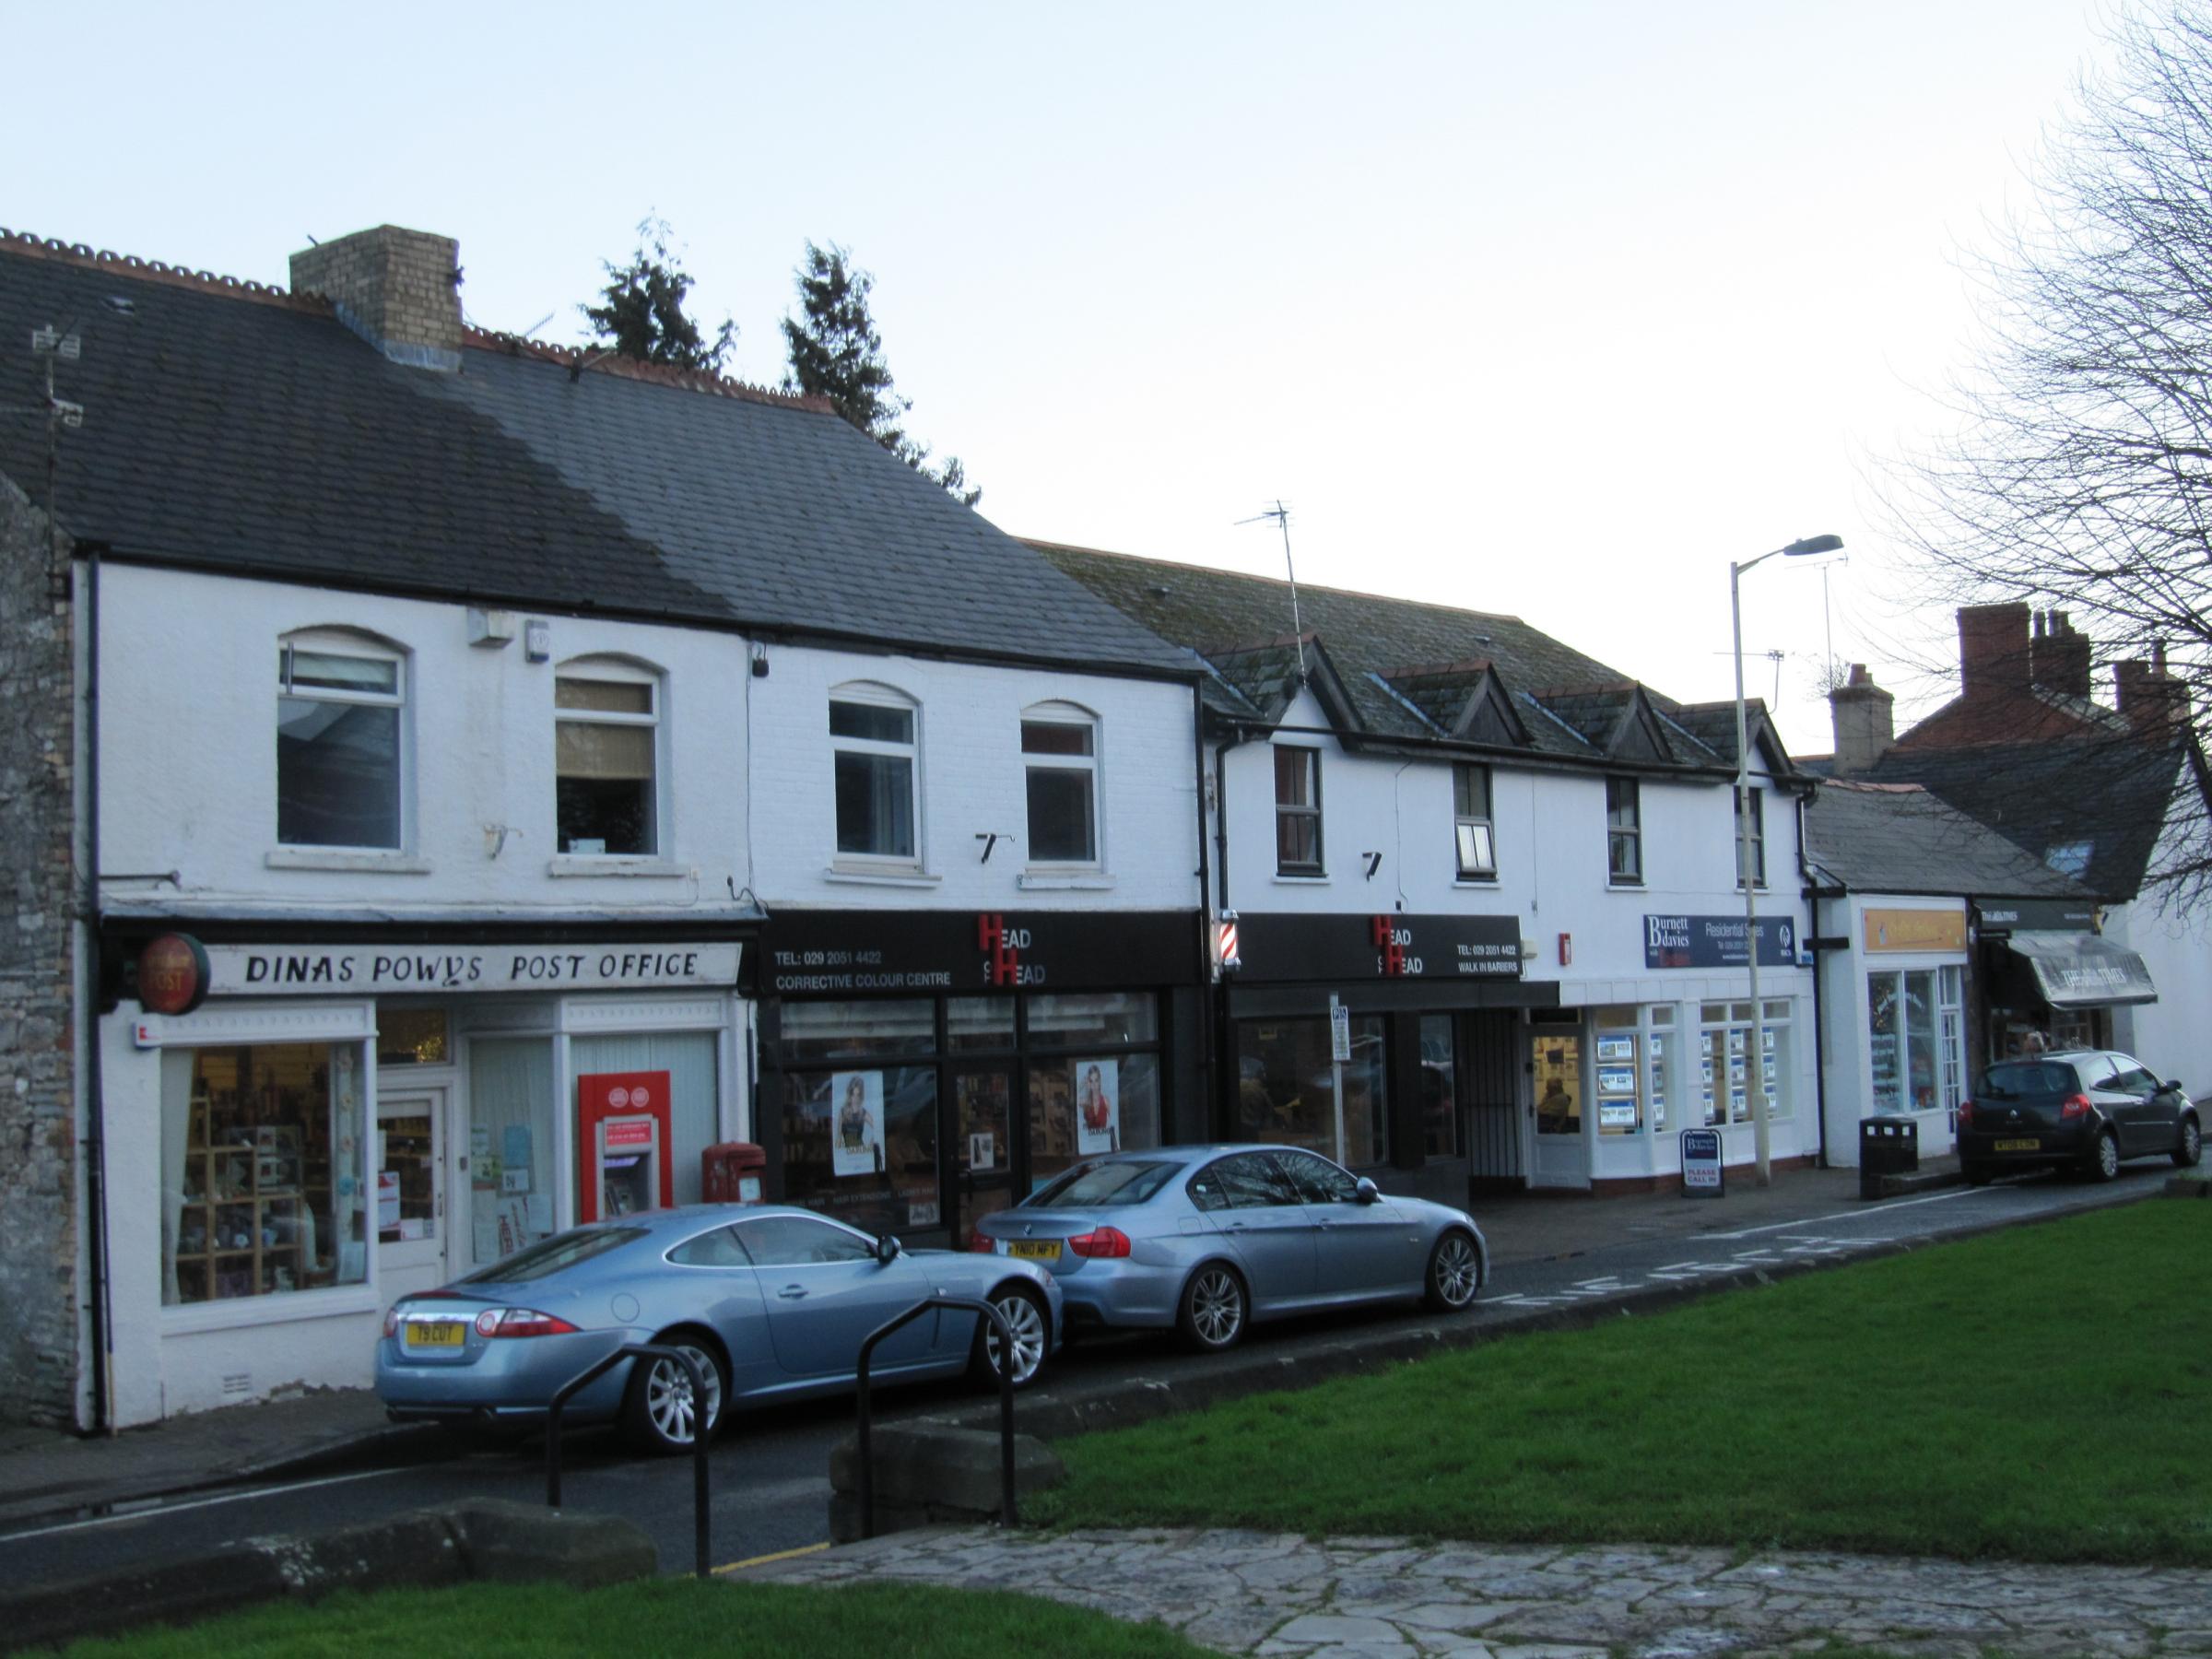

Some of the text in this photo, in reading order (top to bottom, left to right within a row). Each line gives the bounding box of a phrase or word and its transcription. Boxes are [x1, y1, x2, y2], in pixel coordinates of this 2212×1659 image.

[979, 913, 1031, 950] HEAD
[1373, 915, 1411, 947] HEAD
[1648, 916, 1689, 947] Burnett
[1663, 930, 1689, 947] davies
[1705, 923, 1764, 937] Residential Ses
[246, 953, 698, 987] DINAS POWYS POST OFFICE
[775, 950, 882, 966] TEL: 029 2051 4422
[994, 947, 1046, 985] HEAD
[1386, 944, 1422, 975] HEAD
[1458, 960, 1518, 973] WALK IN BARBERS
[776, 972, 951, 991] CORRECTIVE COLOUR CENTRE
